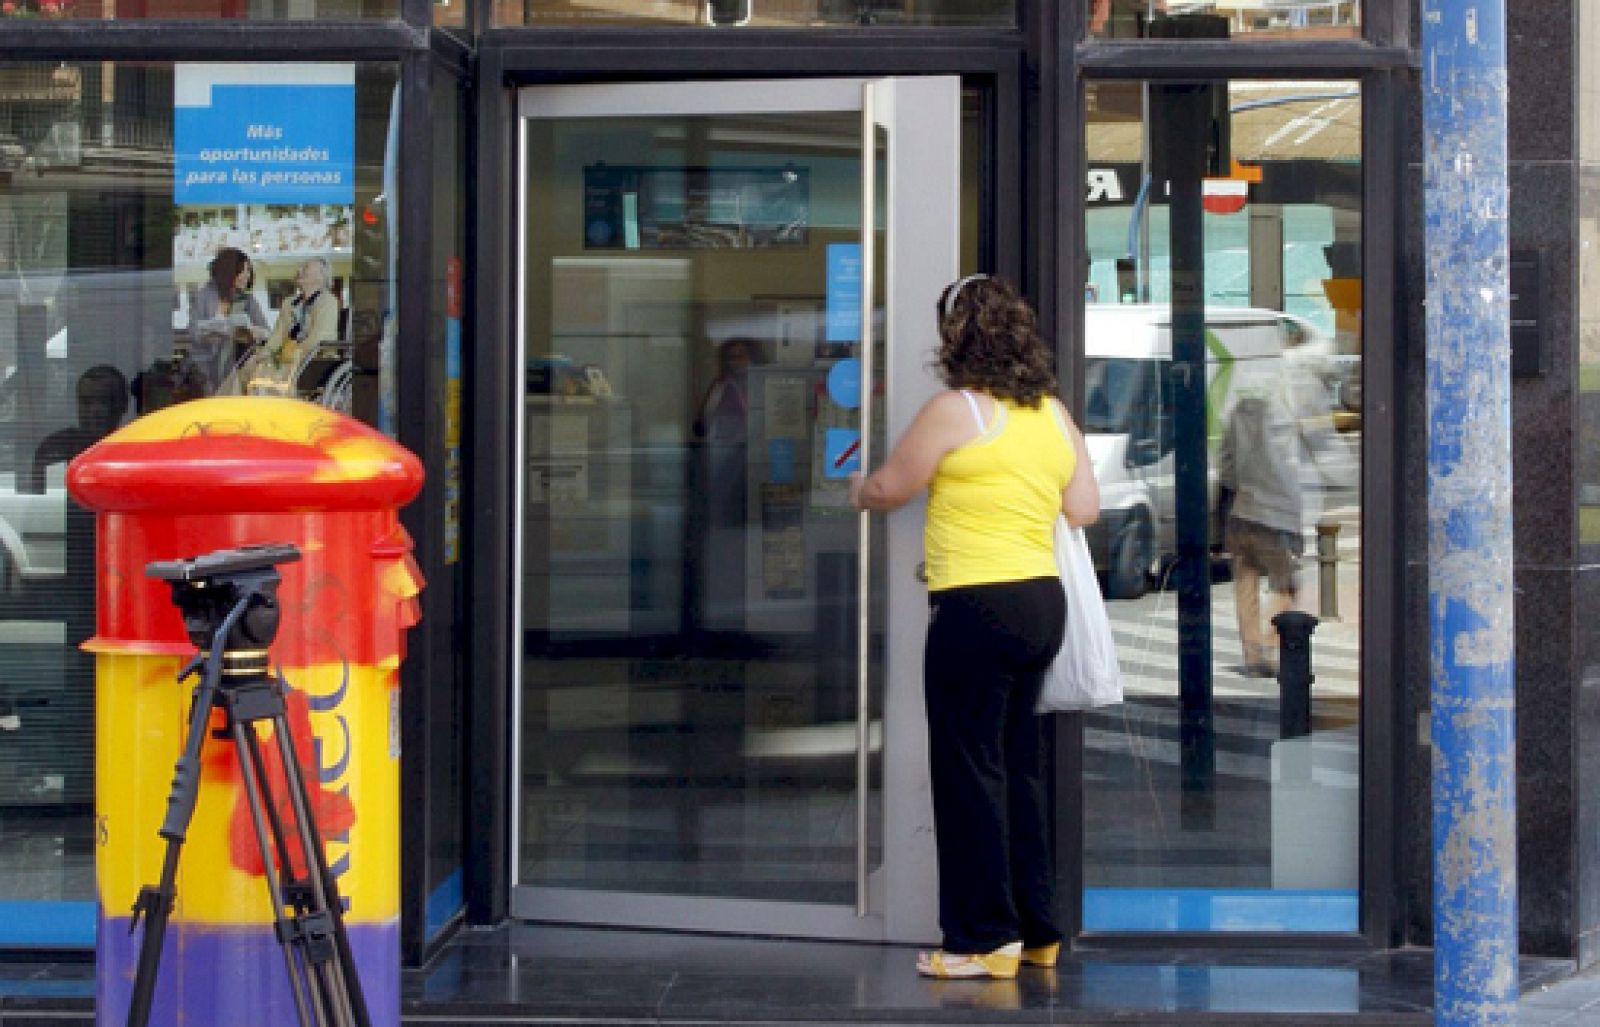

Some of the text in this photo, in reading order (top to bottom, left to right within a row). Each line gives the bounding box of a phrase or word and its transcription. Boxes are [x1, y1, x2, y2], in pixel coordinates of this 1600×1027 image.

[246, 124, 283, 139] Más
[201, 146, 329, 162] oportunidades
[185, 168, 342, 187] para las personas
